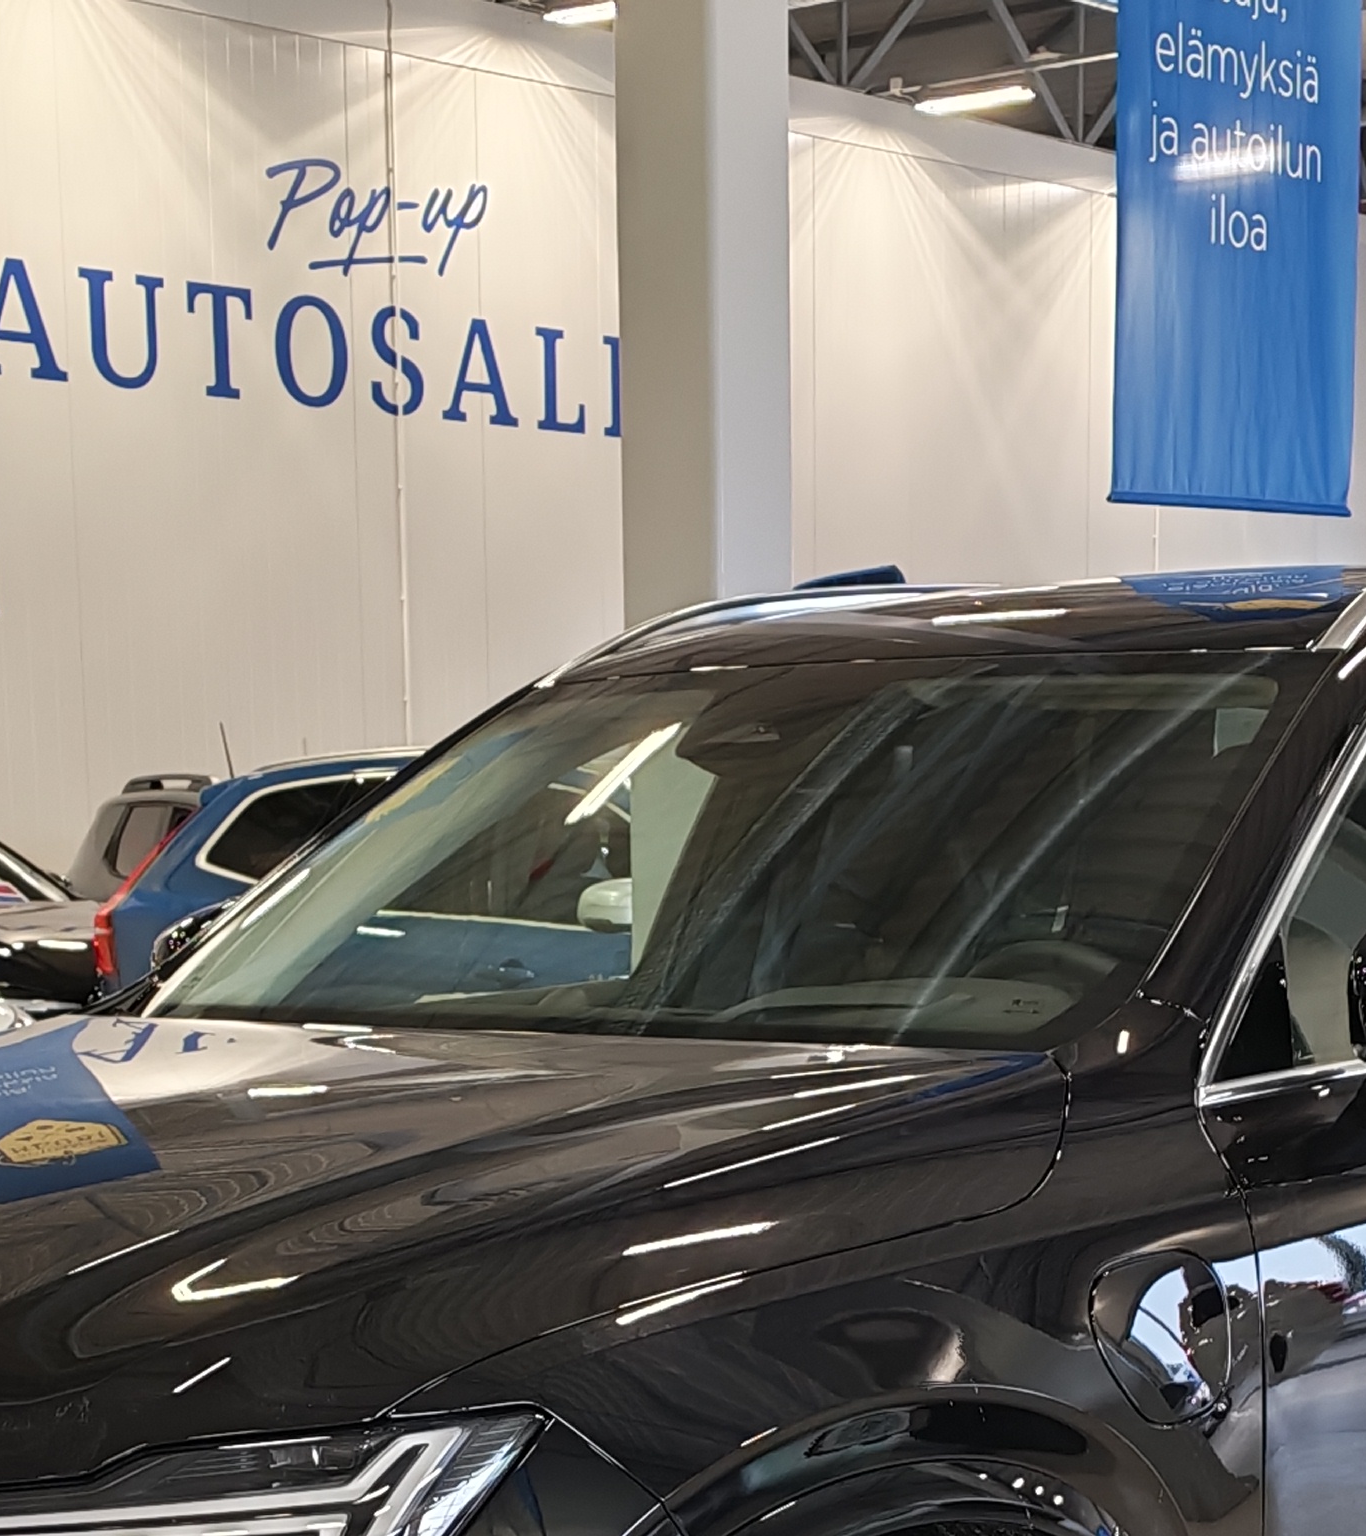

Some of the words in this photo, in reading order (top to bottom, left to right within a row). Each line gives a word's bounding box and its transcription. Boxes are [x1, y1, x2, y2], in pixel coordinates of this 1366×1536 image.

[1155, 22, 1319, 104] elämyksiä
[1149, 101, 1179, 163] ja
[1191, 119, 1322, 183] autoilun
[265, 158, 488, 278] Pop-up
[1209, 194, 1268, 252] iloa
